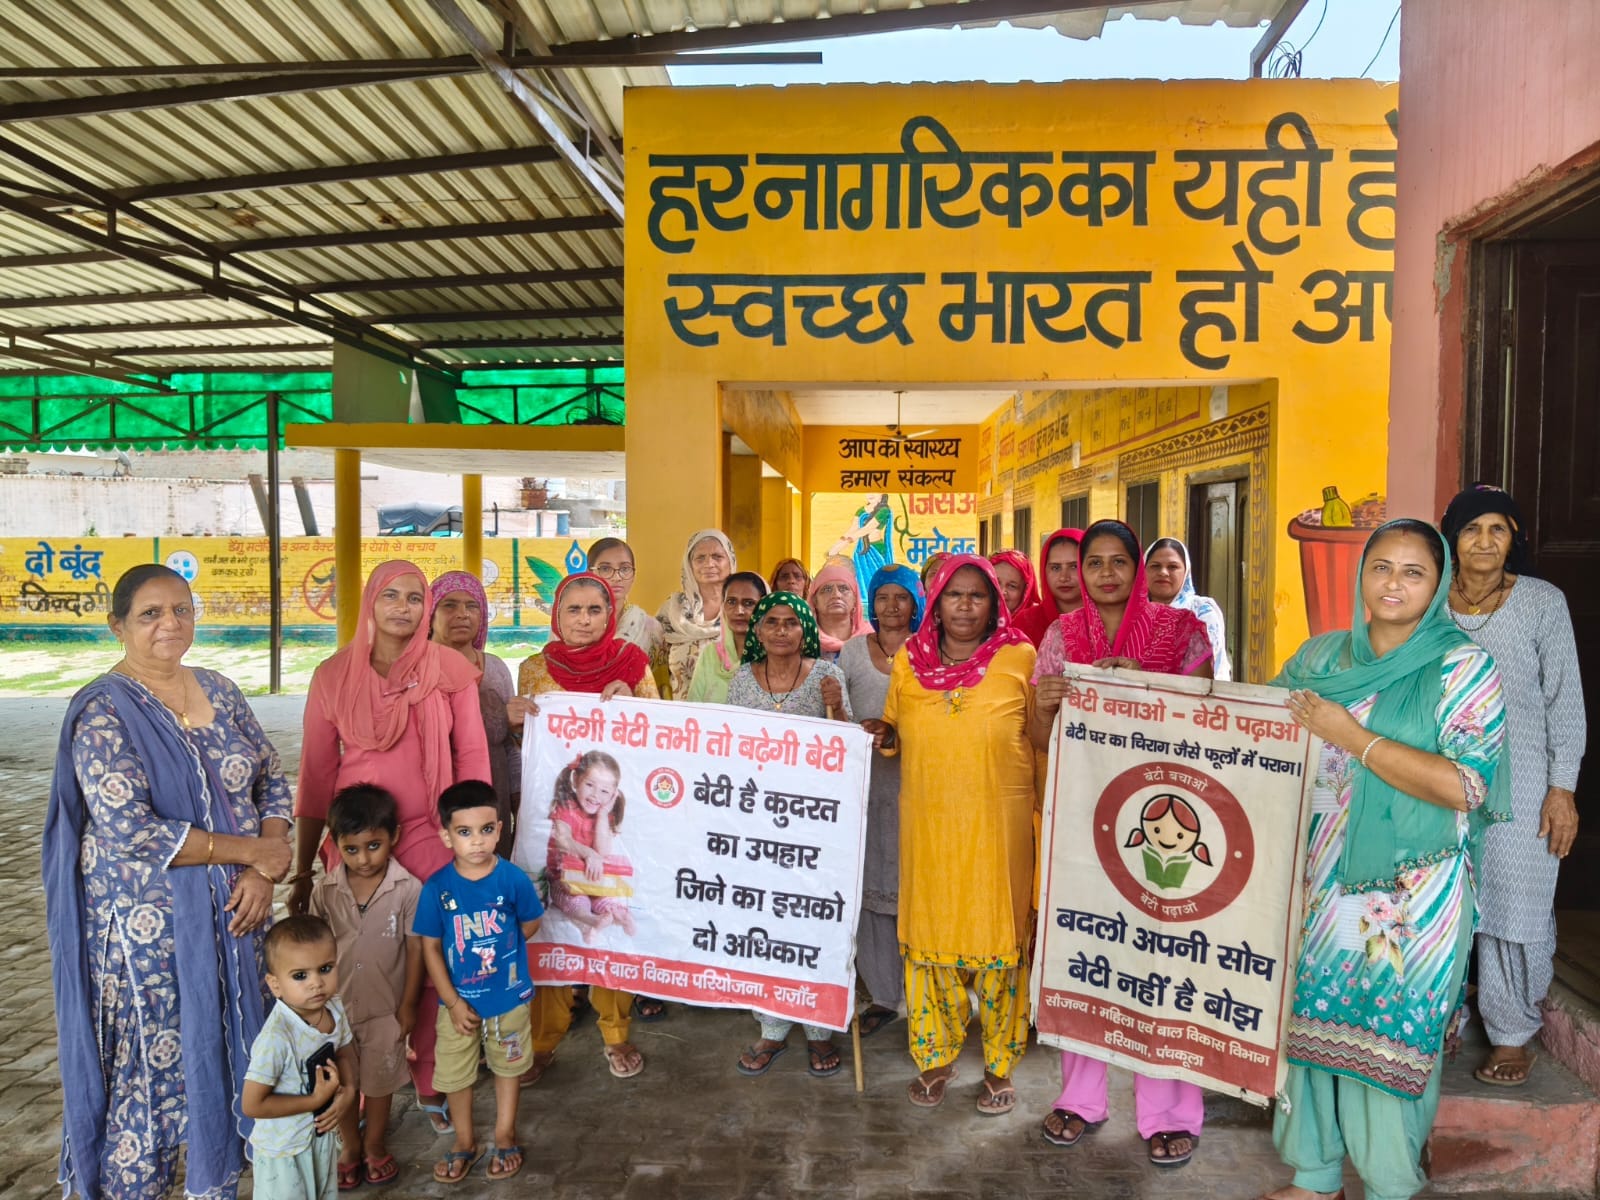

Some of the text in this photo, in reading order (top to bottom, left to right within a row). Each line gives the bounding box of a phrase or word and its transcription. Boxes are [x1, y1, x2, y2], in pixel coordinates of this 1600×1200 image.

[1173, 111, 1333, 255] यही
[664, 240, 1394, 371] स्वच्छ भारत हो अ
[840, 469, 890, 489] हमारा
[897, 464, 956, 489] संकल्प
[25, 541, 104, 580] दो बूंद
[547, 706, 847, 773] पढ़ेगी बेटी तभी तो बढ़ेगी बेटी
[1102, 697, 1167, 722] बचाओ
[1192, 702, 1230, 732] बेटी
[1235, 715, 1302, 743] पढ़ाओ
[1065, 722, 1087, 741] बेटी
[1089, 730, 1107, 745] घर
[1109, 733, 1128, 748] का
[1131, 731, 1171, 755] चिराग
[1173, 739, 1201, 760] जैसे
[1204, 747, 1241, 770] फूलों
[1241, 749, 1258, 768] में
[693, 772, 841, 829] बेटी है कुदरत
[1143, 766, 1209, 793] बेटी बचाओ
[706, 831, 821, 870] का उपहार
[675, 867, 846, 923] जिने का इसको
[453, 908, 504, 956] INK
[692, 920, 821, 970] दो अधिकार
[1056, 908, 1277, 982] बदलो अपनी सोच
[538, 946, 585, 971] महिला
[588, 955, 608, 976] एवं
[642, 960, 689, 988] विकास
[1068, 951, 1264, 1032] बेटी नहीं है बोझ
[1099, 1006, 1135, 1029] महिला
[1137, 1020, 1157, 1036] एवं
[1157, 1025, 1184, 1039] बाल
[1186, 1025, 1227, 1053] विकास
[1229, 1040, 1271, 1067] विभाग
[1156, 1044, 1205, 1069] पंचकूला
